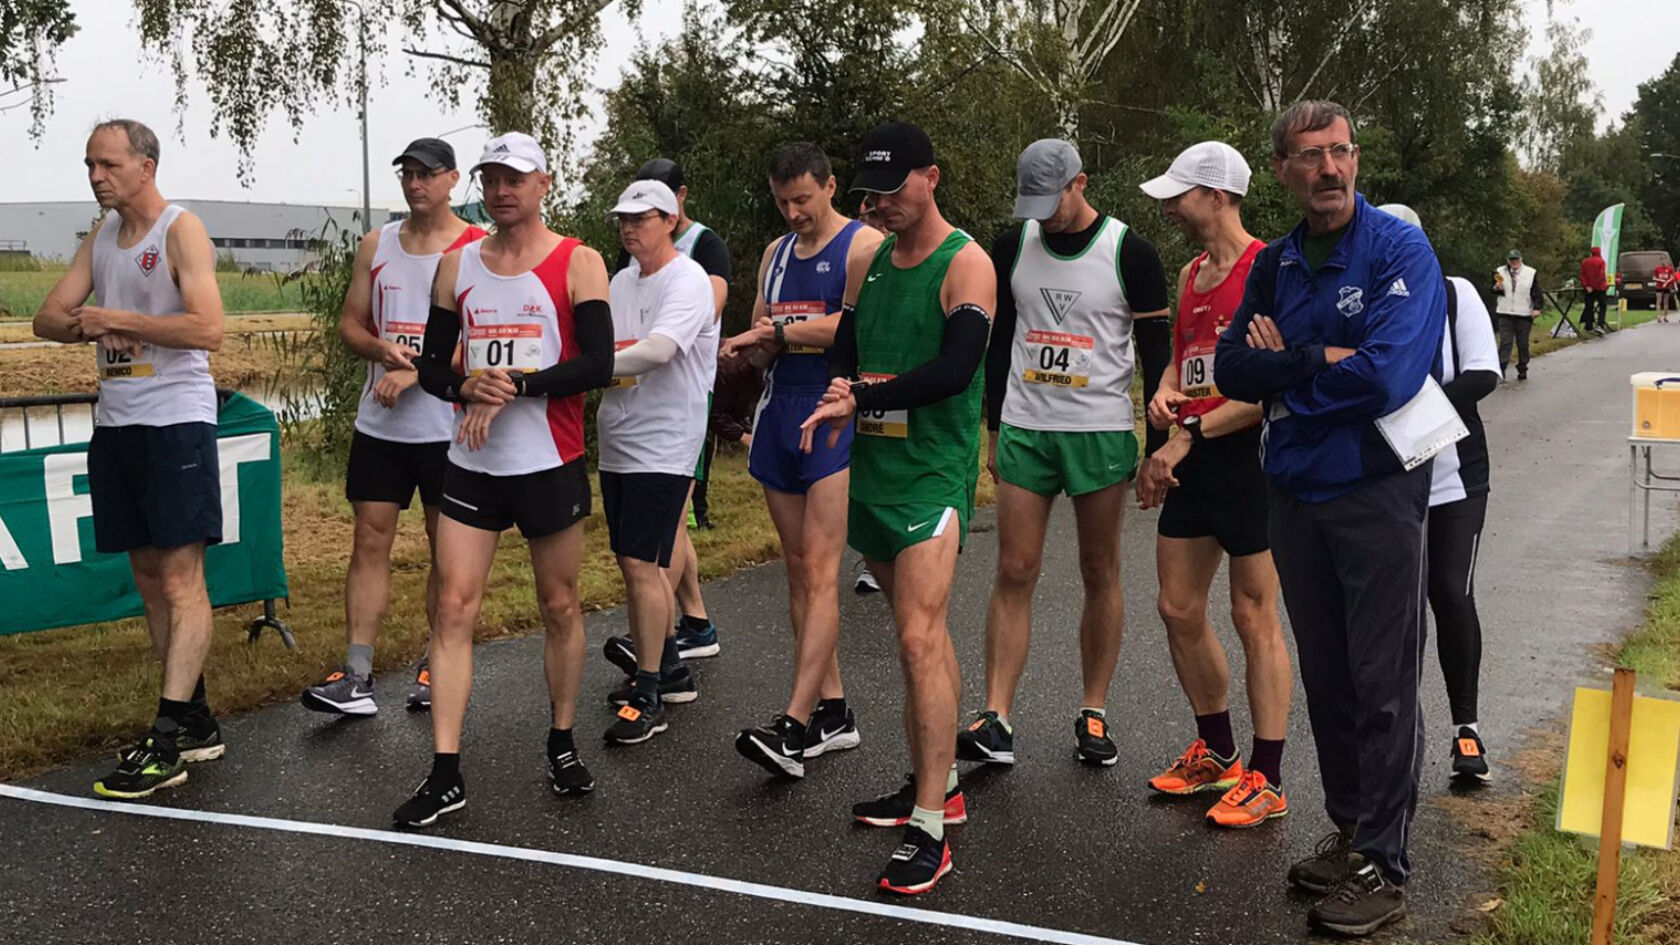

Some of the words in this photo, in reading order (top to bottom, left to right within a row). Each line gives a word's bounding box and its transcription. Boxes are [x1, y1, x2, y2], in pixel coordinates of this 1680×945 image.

[487, 340, 514, 366] 01
[1040, 346, 1069, 371] 04
[1186, 358, 1205, 385] 09
